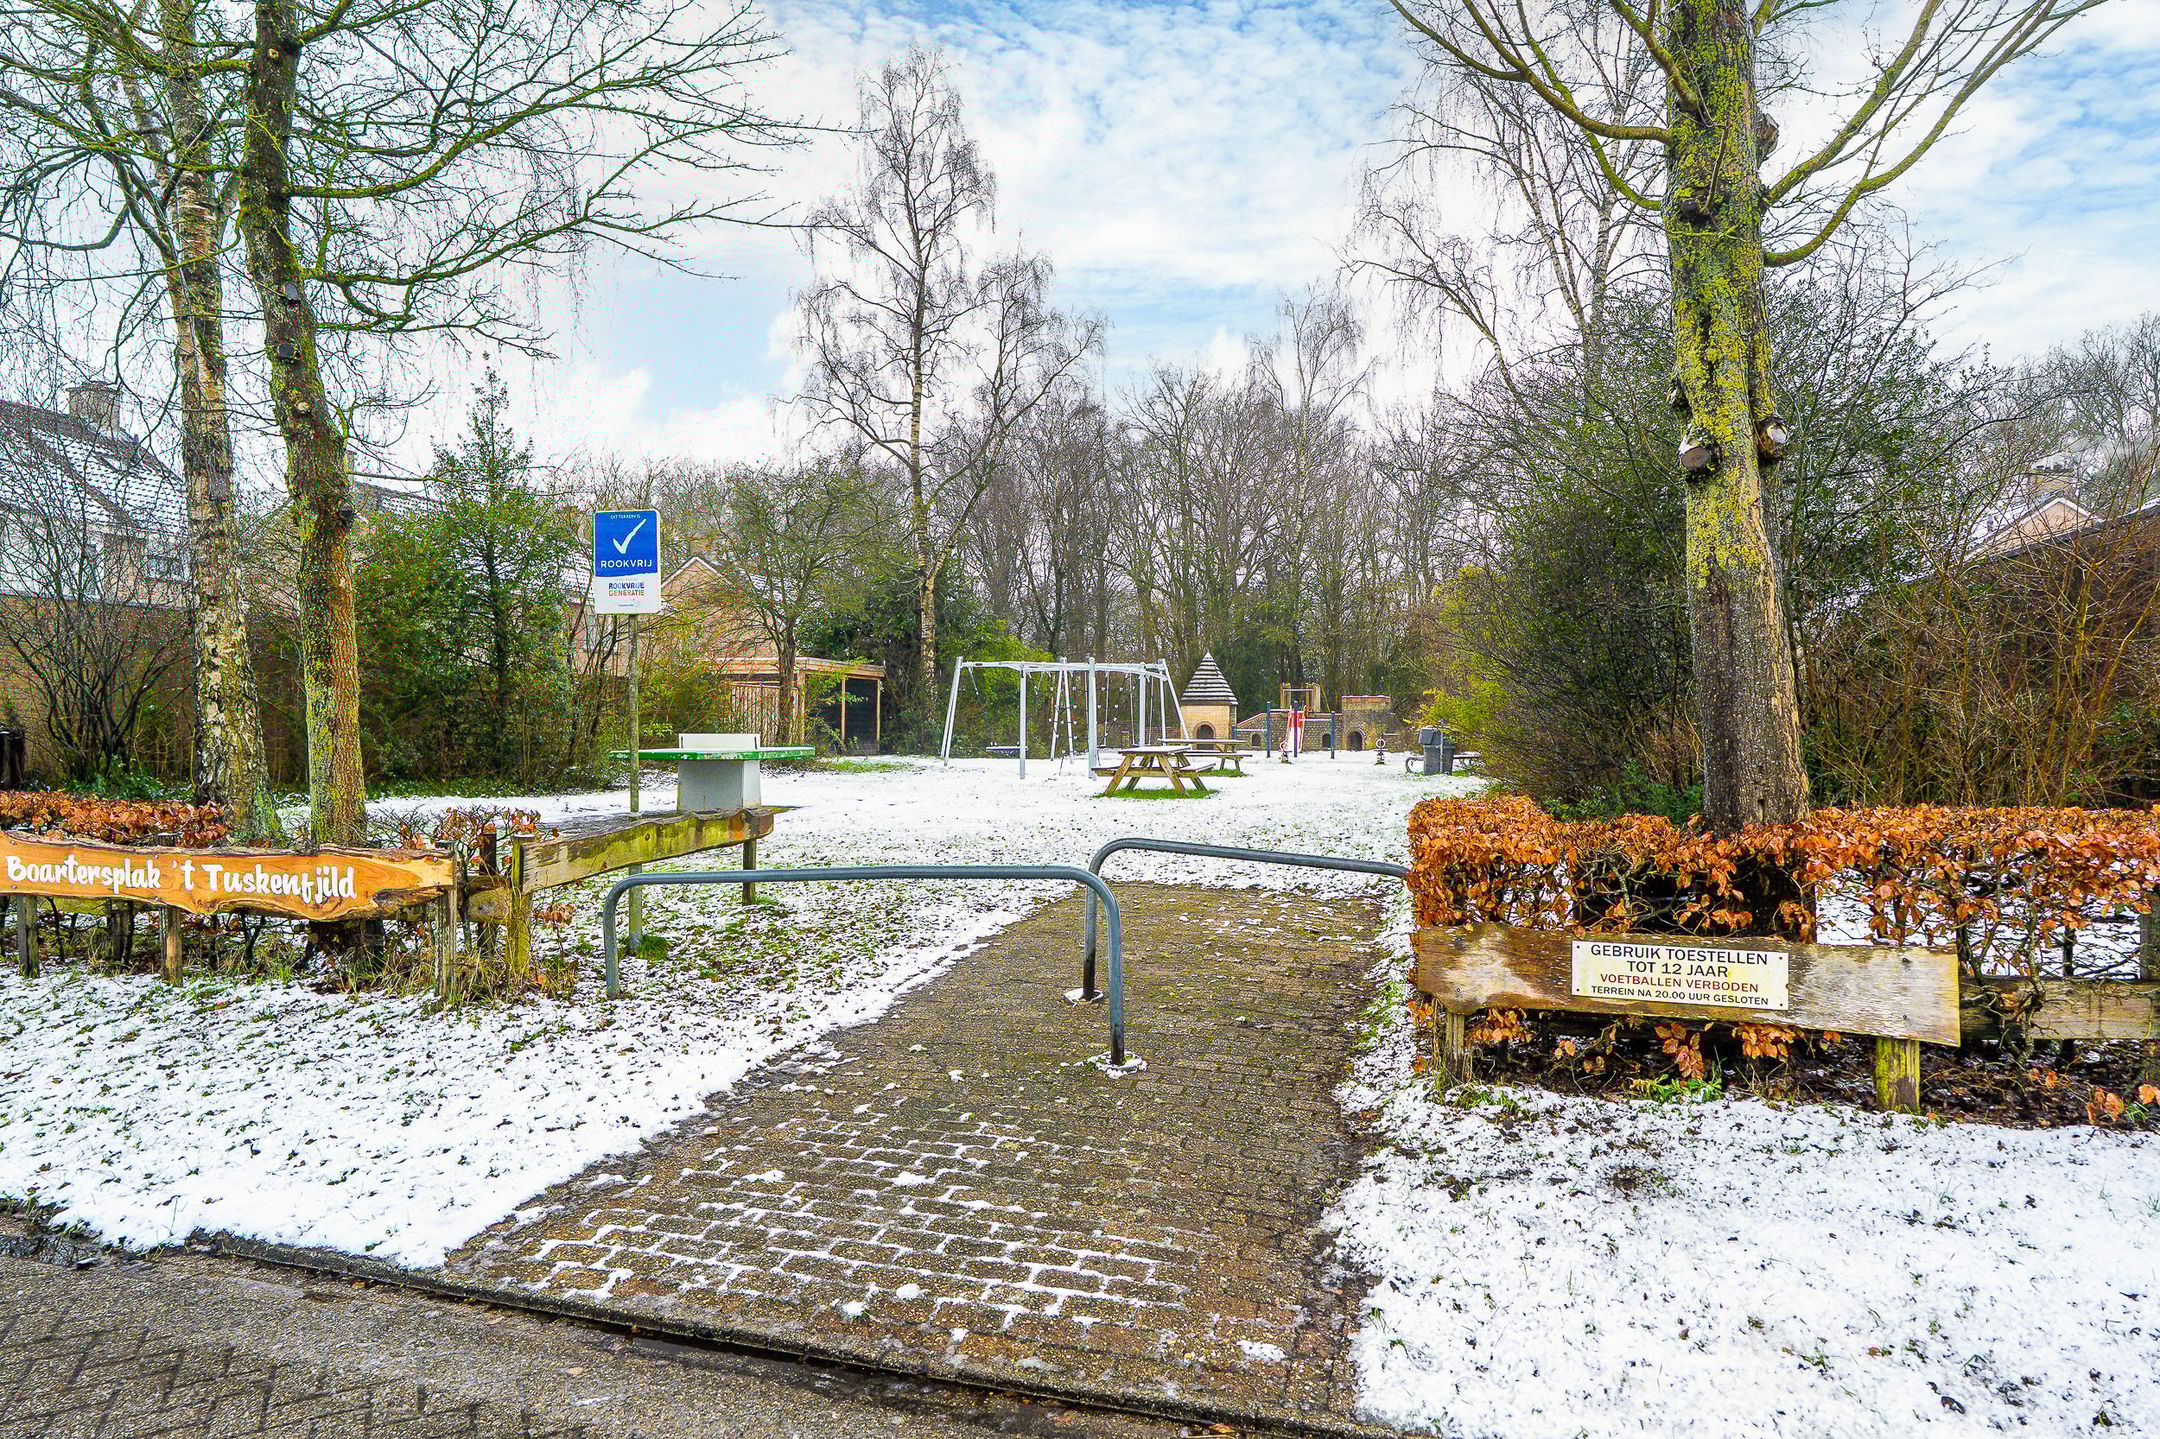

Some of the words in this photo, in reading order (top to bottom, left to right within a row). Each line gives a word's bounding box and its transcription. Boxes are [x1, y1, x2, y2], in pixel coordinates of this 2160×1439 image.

[600, 559, 653, 568] ROOKVRIJ
[5, 854, 161, 895] Boartersplak
[200, 863, 358, 904] Tuskenfjild
[1590, 944, 1661, 960] GEBRUIK
[1665, 948, 1768, 966] TOESTELLEN
[1626, 960, 1656, 974] TOT
[1661, 962, 1682, 975] 12
[1687, 964, 1729, 978] JAAR
[1600, 973, 1682, 988] VOETBALLEN
[1685, 979, 1759, 993] VERBODEN
[1591, 985, 1635, 996] TERREIN
[1637, 988, 1652, 998] NA
[1655, 990, 1685, 1000] 20.00
[1688, 992, 1711, 1002] UUR
[1713, 994, 1769, 1006] GESLOTEN
